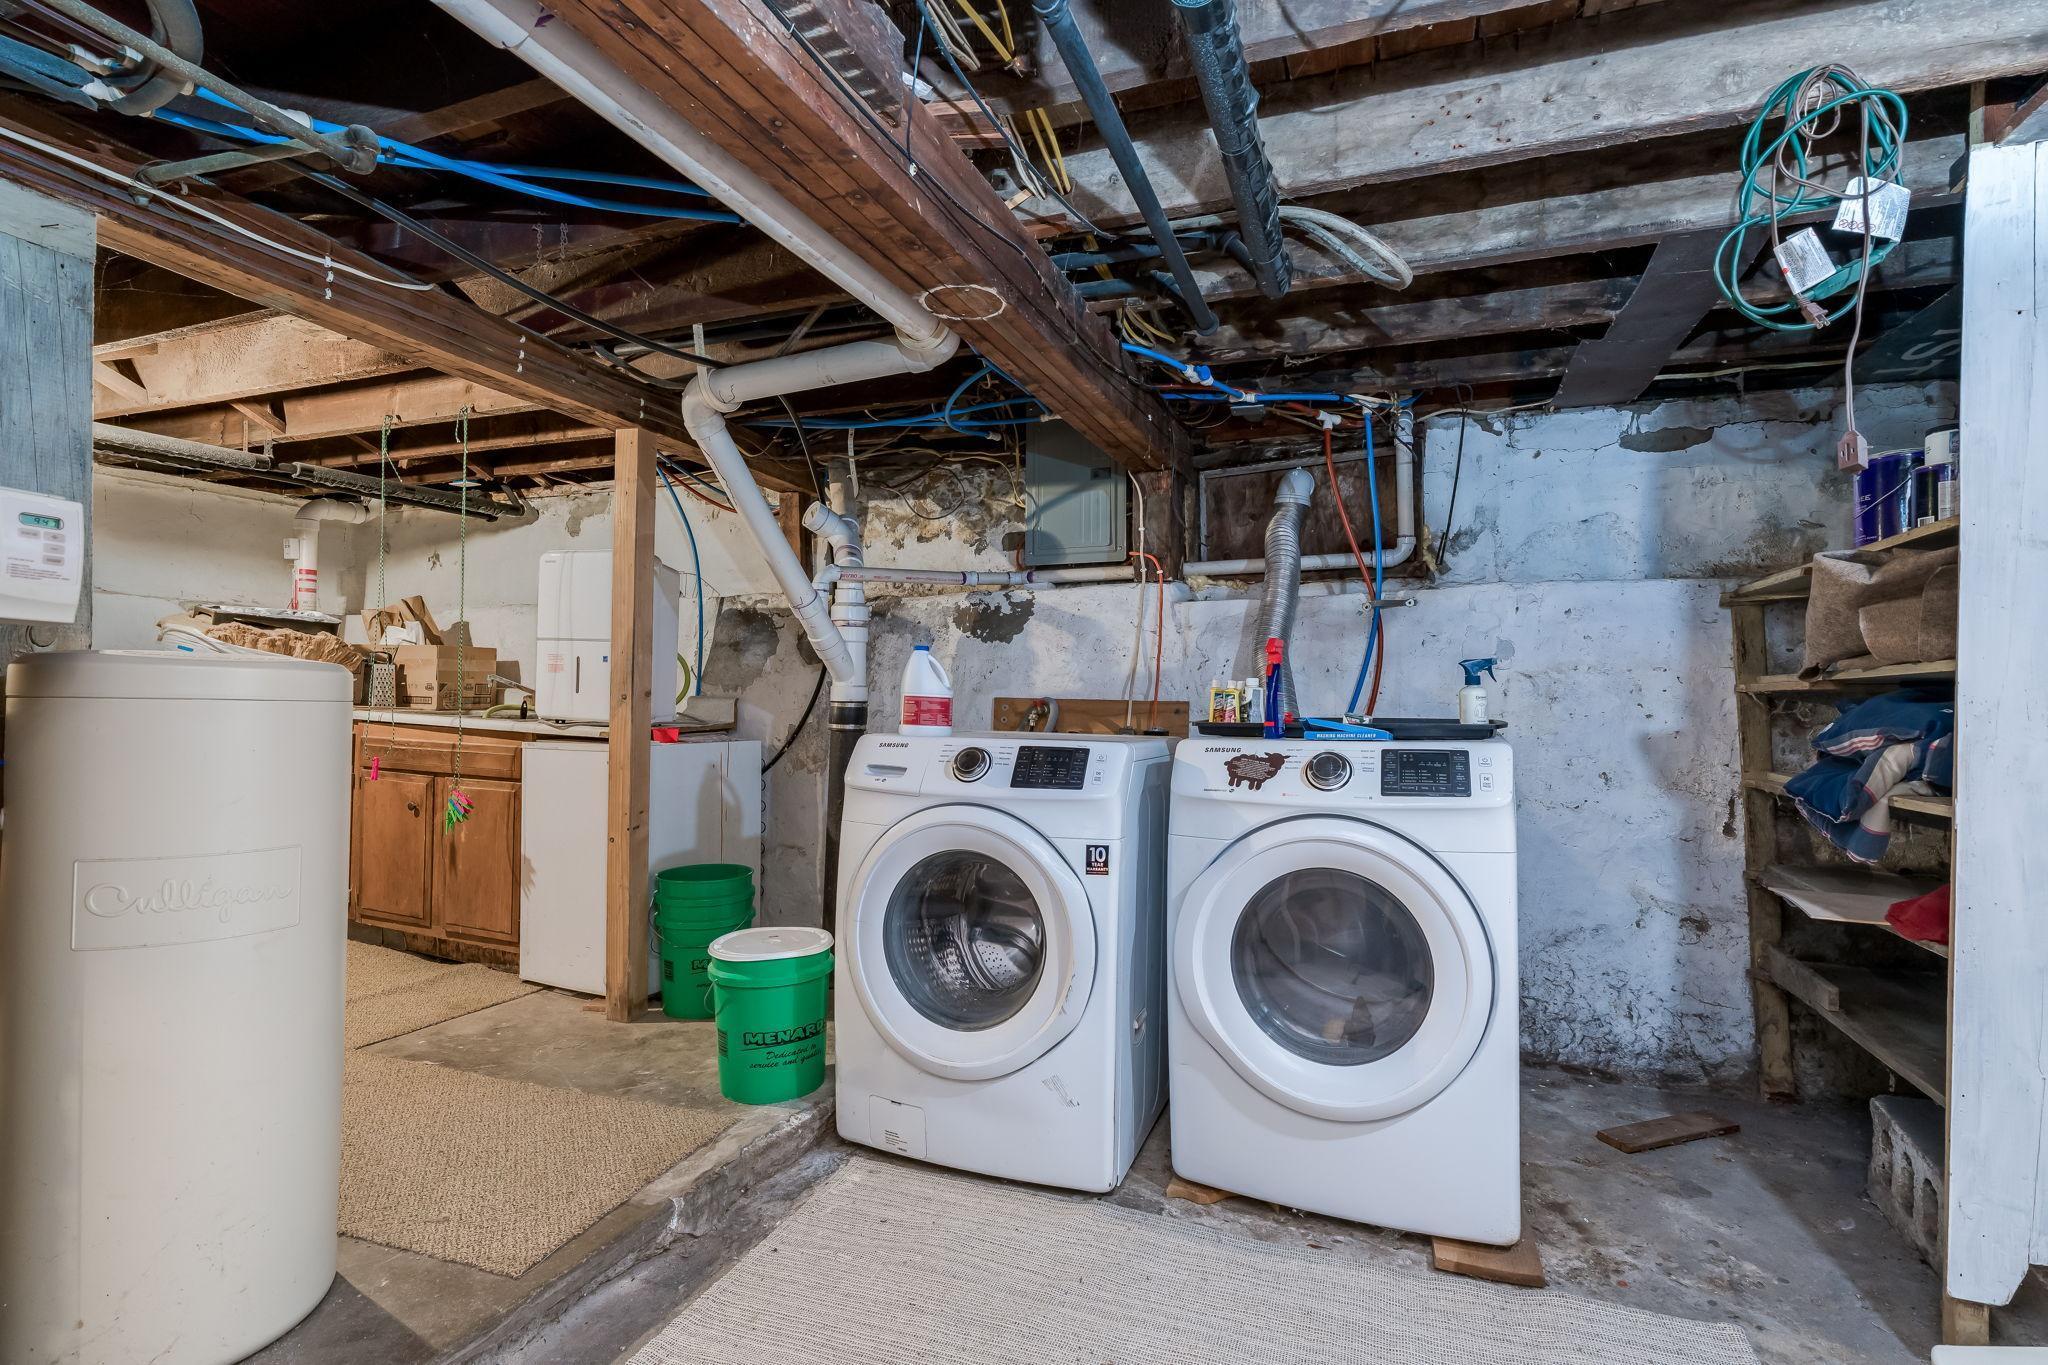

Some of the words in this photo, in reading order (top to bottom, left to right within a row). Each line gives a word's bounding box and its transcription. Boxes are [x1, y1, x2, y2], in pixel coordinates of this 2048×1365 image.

[1089, 847, 1106, 863] 10
[84, 875, 293, 923] Culligan
[766, 1044, 809, 1060] Dedicated
[749, 1061, 779, 1069] service
[782, 1056, 799, 1066] and
